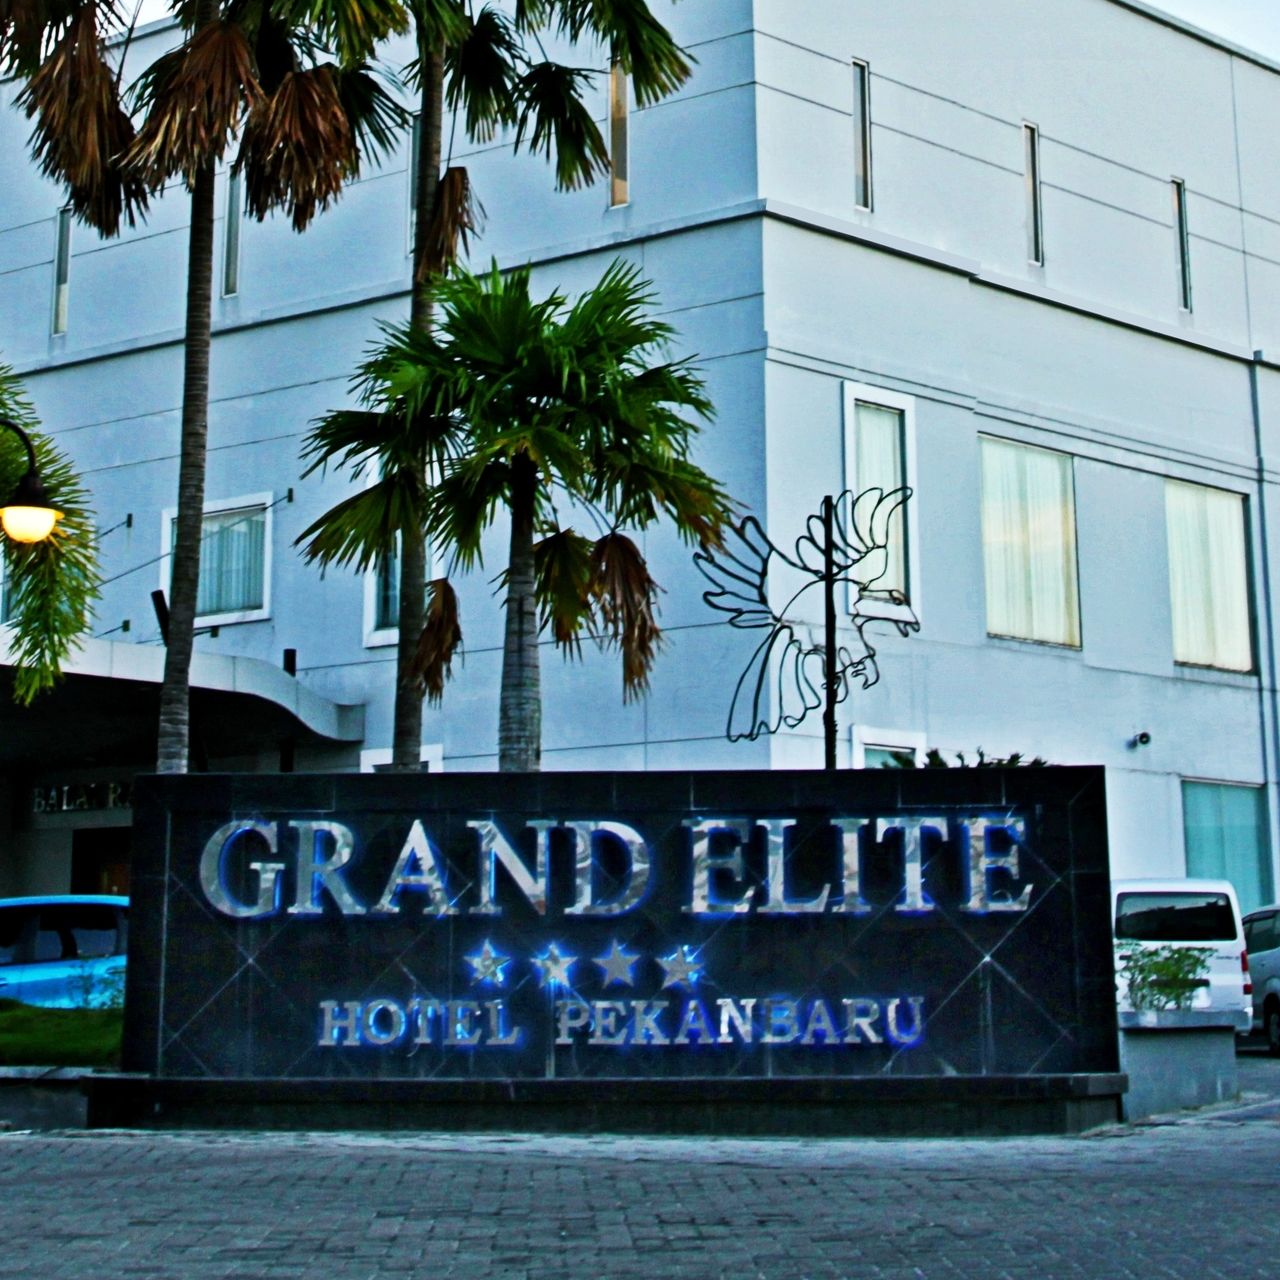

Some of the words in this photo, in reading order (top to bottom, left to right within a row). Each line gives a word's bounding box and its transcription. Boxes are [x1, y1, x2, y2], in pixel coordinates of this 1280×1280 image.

[199, 819, 652, 918] GRAND
[680, 816, 1035, 914] ELITE
[320, 999, 521, 1047] HOTEL
[554, 996, 925, 1046] PEKANBARU
